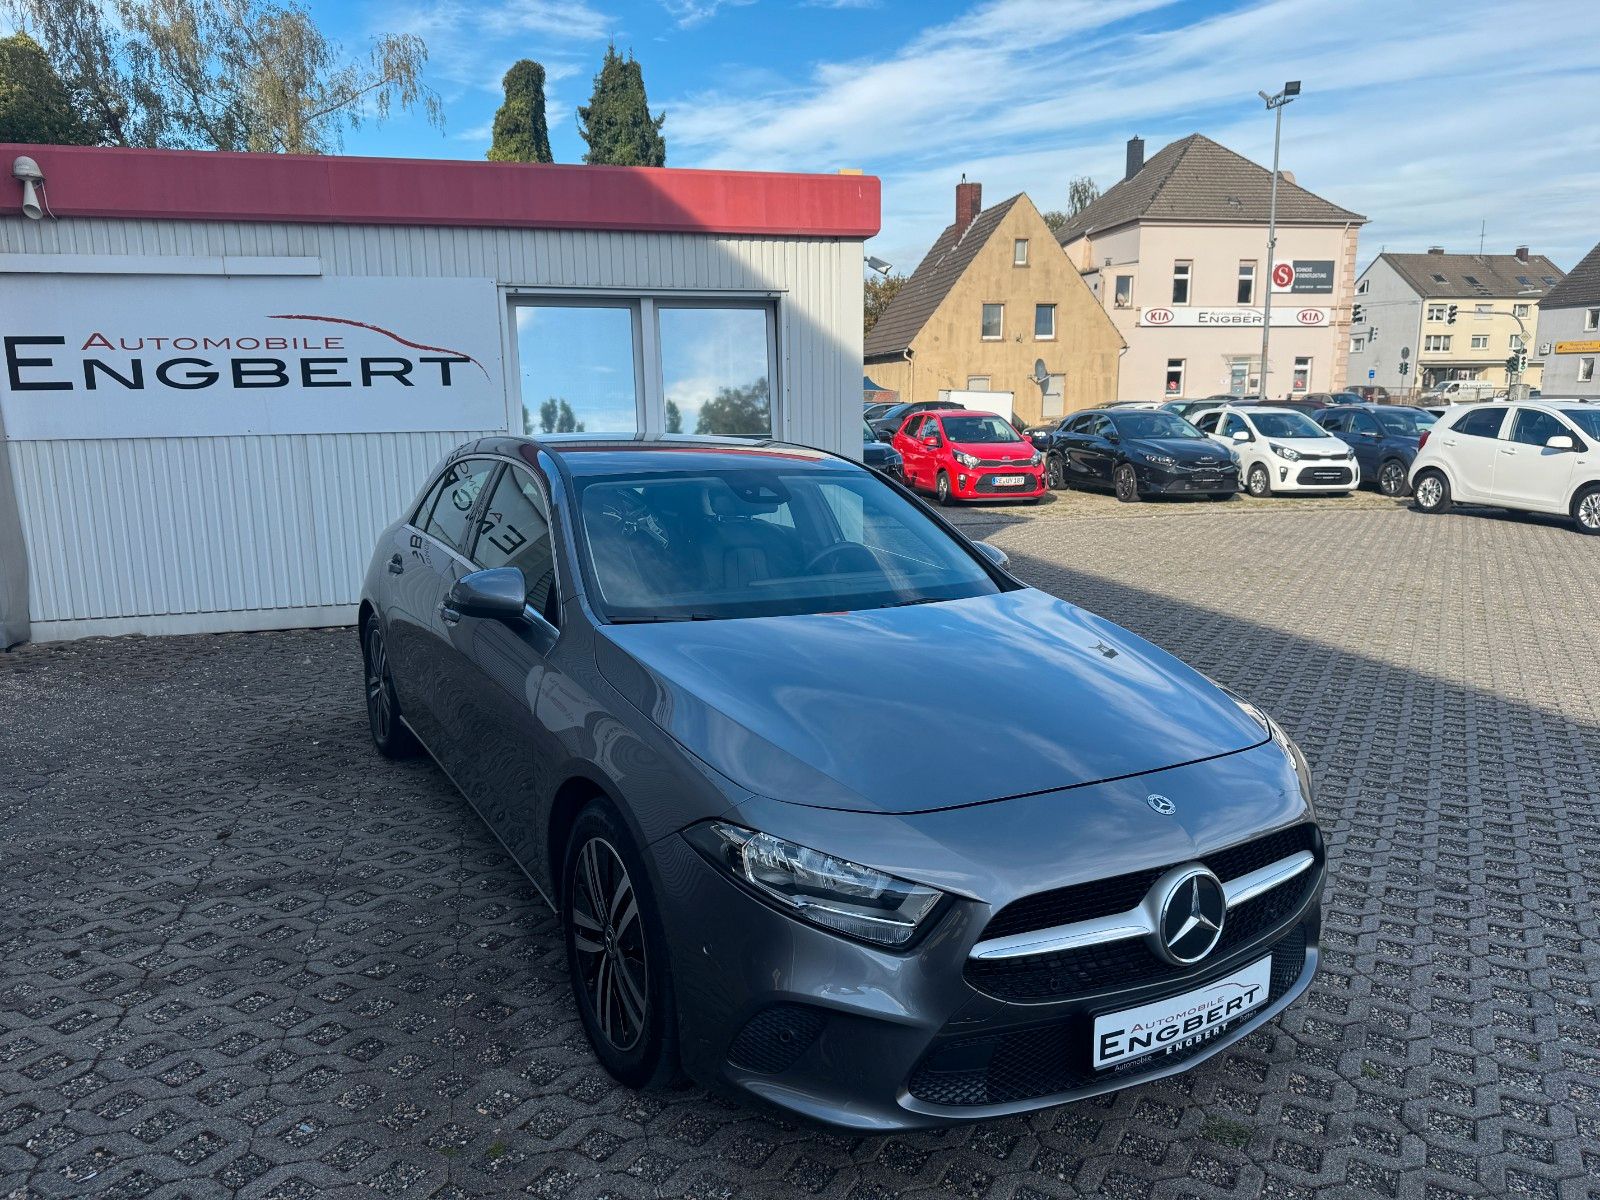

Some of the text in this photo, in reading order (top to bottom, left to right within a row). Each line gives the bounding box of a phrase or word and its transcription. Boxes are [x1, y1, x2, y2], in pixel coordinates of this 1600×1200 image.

[1150, 312, 1169, 321] KIA
[1301, 312, 1319, 321] KIA
[81, 332, 345, 351] AUTOMOBILE
[3, 335, 471, 391] ENGBERT
[1099, 986, 1260, 1061] ENGBERT
[1131, 995, 1225, 1034] AUTOMOBILE
[1114, 1055, 1153, 1072] Automobile
[1165, 1022, 1229, 1055] ENGBERT
